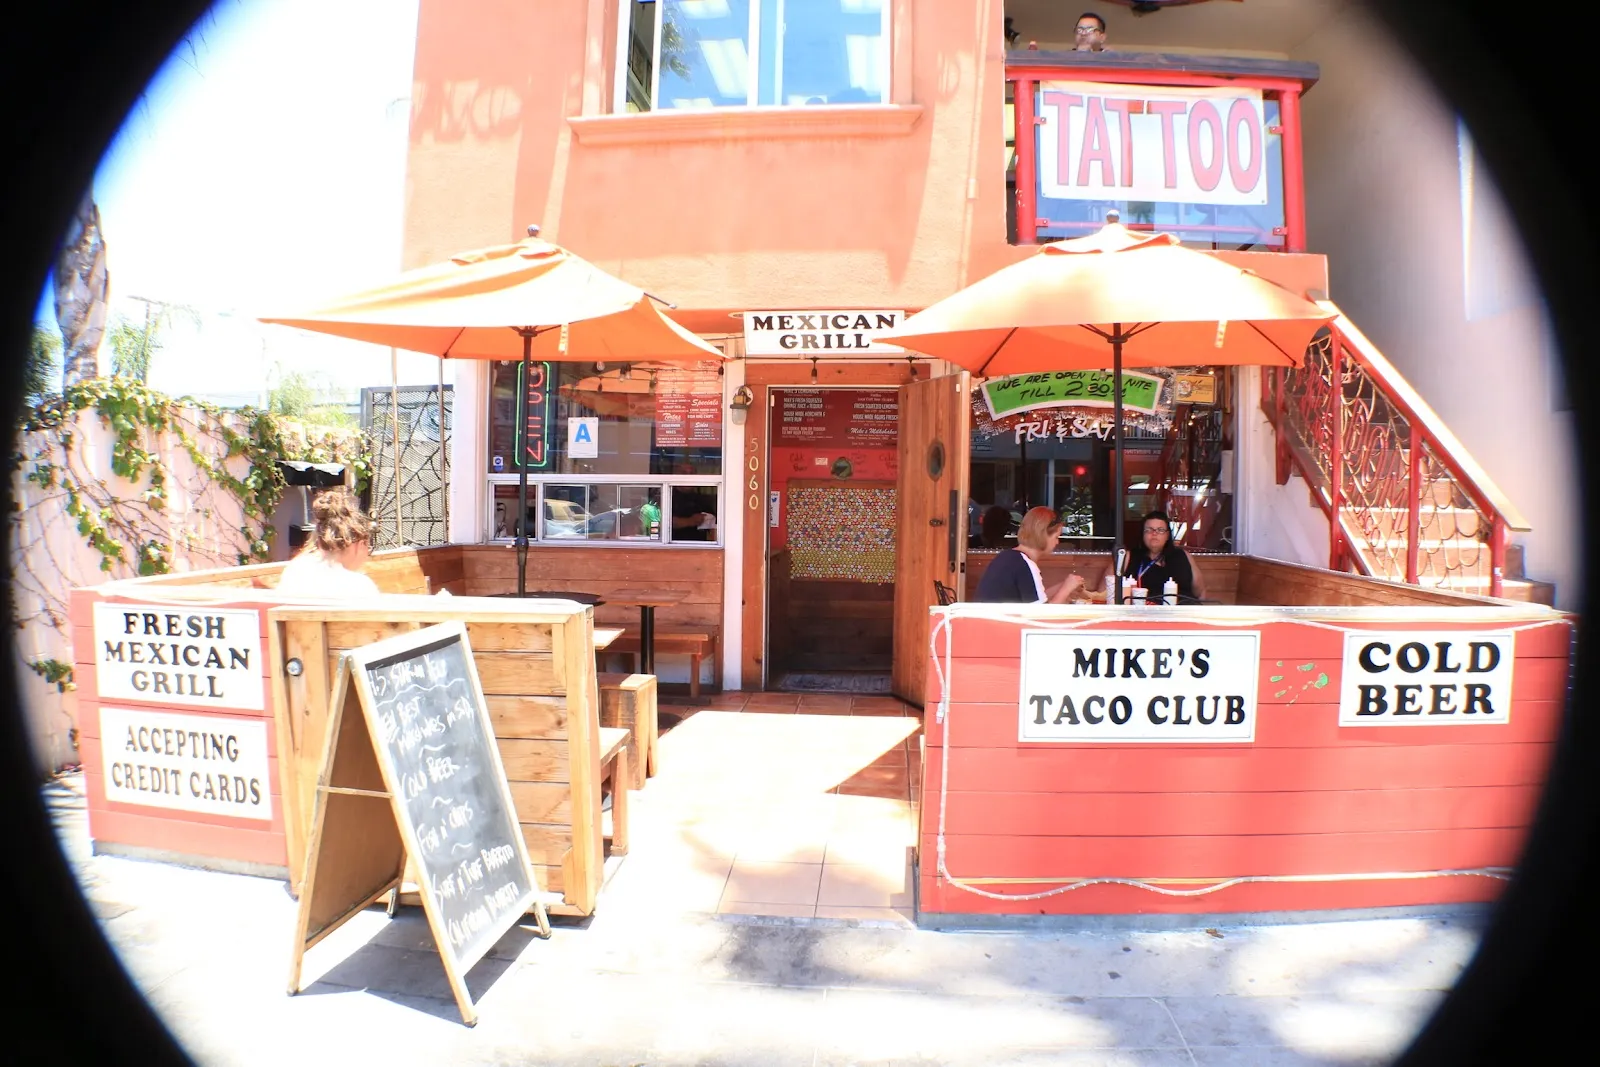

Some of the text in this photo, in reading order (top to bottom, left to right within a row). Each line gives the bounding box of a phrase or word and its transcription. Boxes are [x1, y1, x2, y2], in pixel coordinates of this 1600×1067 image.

[1043, 90, 1262, 194] TATTOO
[752, 314, 896, 331] MEXICAN
[779, 334, 870, 349] GRILL
[997, 371, 1152, 392] WE ARE OPEN LT NITE
[1020, 387, 1056, 400] TILL
[691, 398, 719, 407] Specials
[574, 423, 592, 443] A
[1056, 420, 1068, 443] &
[749, 438, 759, 510] 5060
[123, 612, 226, 639] FRESH
[104, 640, 250, 670] MEXICAN
[1072, 648, 1211, 678] MIKE'S
[1358, 641, 1501, 674] COLD
[131, 670, 224, 698] GRILL
[1029, 695, 1246, 725] TACO CLUB
[1356, 683, 1494, 716] BEER
[125, 725, 239, 762] ACCEPTING
[112, 762, 261, 805] CREDIT CARDS
